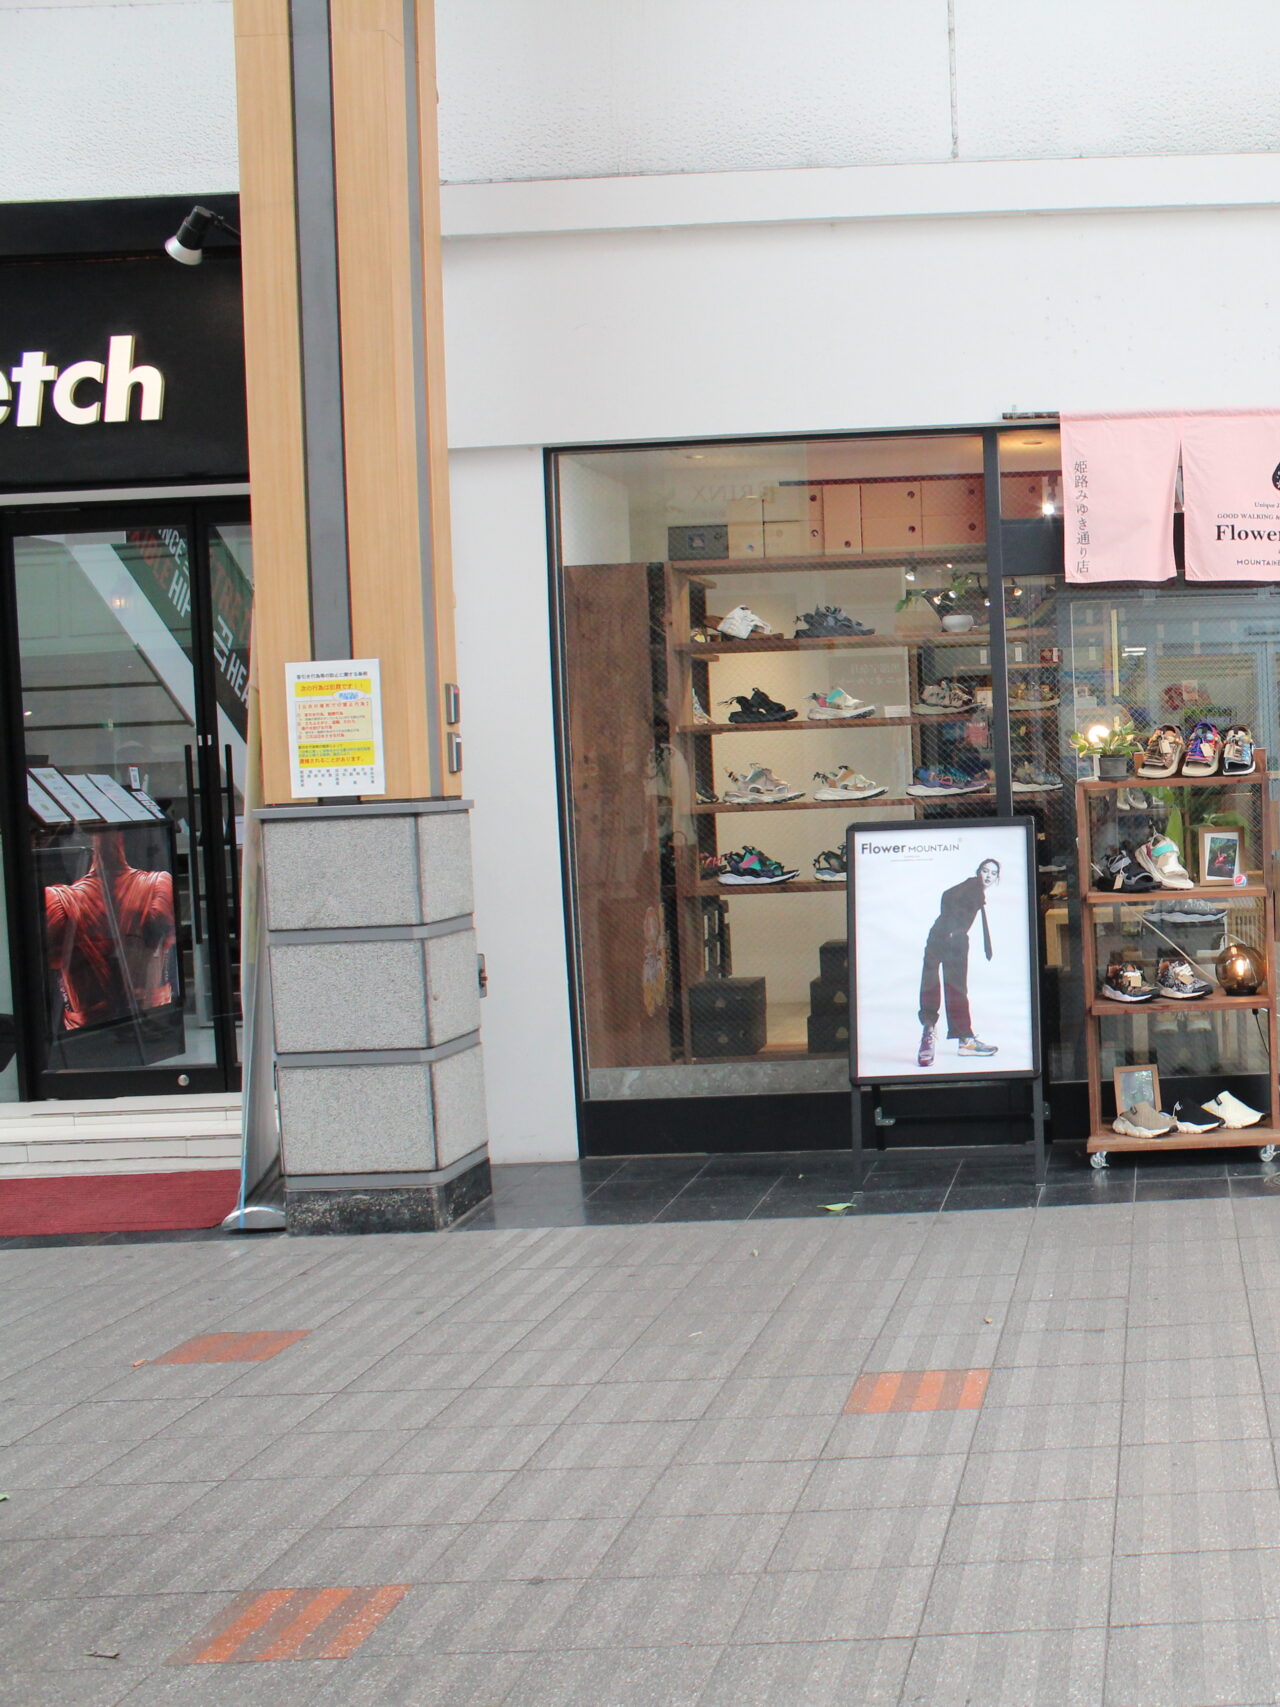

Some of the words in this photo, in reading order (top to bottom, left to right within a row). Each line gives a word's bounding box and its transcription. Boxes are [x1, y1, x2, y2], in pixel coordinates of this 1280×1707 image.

[1074, 460, 1090, 574] 姫路みゆき通り店
[861, 842, 906, 855] Flower
[908, 843, 960, 853] MOUNTAIN
